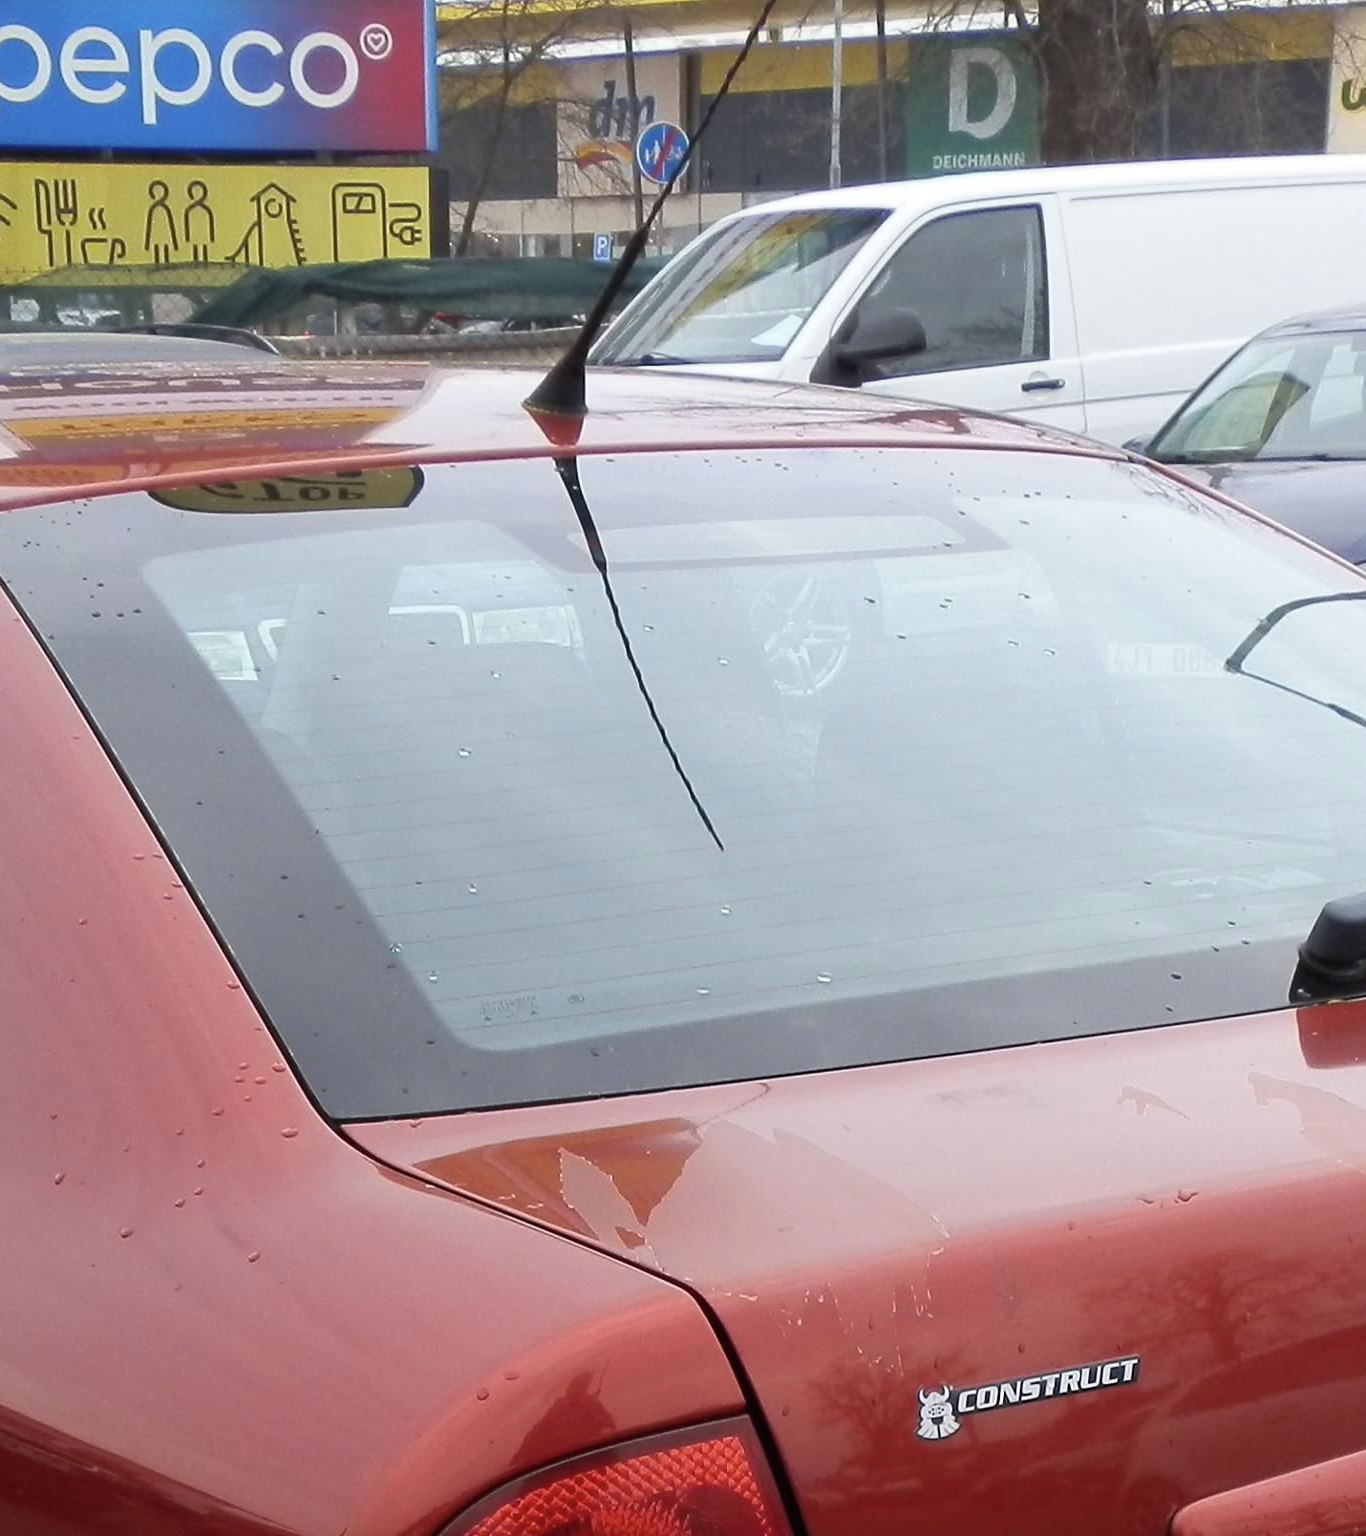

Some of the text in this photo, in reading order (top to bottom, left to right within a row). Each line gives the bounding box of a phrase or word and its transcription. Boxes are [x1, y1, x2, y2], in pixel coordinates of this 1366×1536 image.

[588, 79, 656, 138] dm
[949, 47, 1017, 140] D
[932, 151, 1026, 169] DEICHMANN
[597, 236, 608, 256] P
[957, 1358, 1138, 1413] CONSTRUCT
